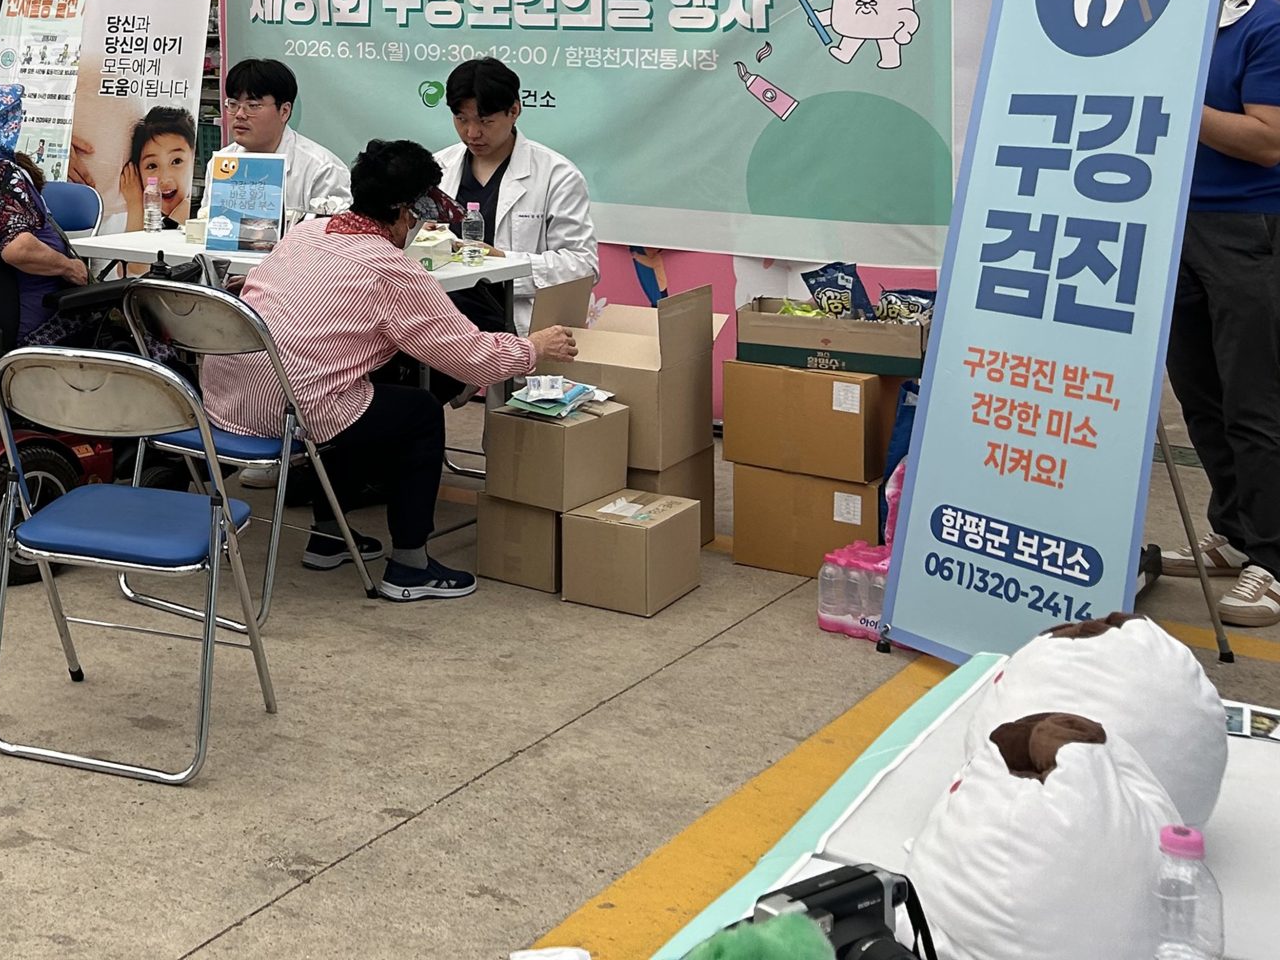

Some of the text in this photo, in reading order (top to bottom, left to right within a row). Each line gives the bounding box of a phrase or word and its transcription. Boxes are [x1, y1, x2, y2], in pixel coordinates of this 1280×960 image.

[107, 15, 151, 34] 당신과
[104, 36, 183, 55] 당신의 아기
[284, 40, 411, 62] 2026.6.15.(월)
[414, 43, 548, 64] 09:30~12:00
[564, 46, 719, 71] 함평천지전통시장
[101, 58, 161, 77] 모두에게
[99, 79, 189, 98] 도움이됩니다
[521, 90, 557, 108] 건소
[994, 93, 1171, 203] 구강
[239, 200, 256, 211] 상담
[258, 200, 276, 212] 부스
[975, 208, 1148, 334] 검진
[963, 346, 1120, 411] 구강검진 받고,
[971, 391, 1098, 449] 건강한 미소
[983, 440, 1068, 489] 지켜요!
[941, 507, 1091, 582] 함평군 보건소
[924, 551, 1094, 622] 061)320-2414
[860, 618, 879, 629] 아이
